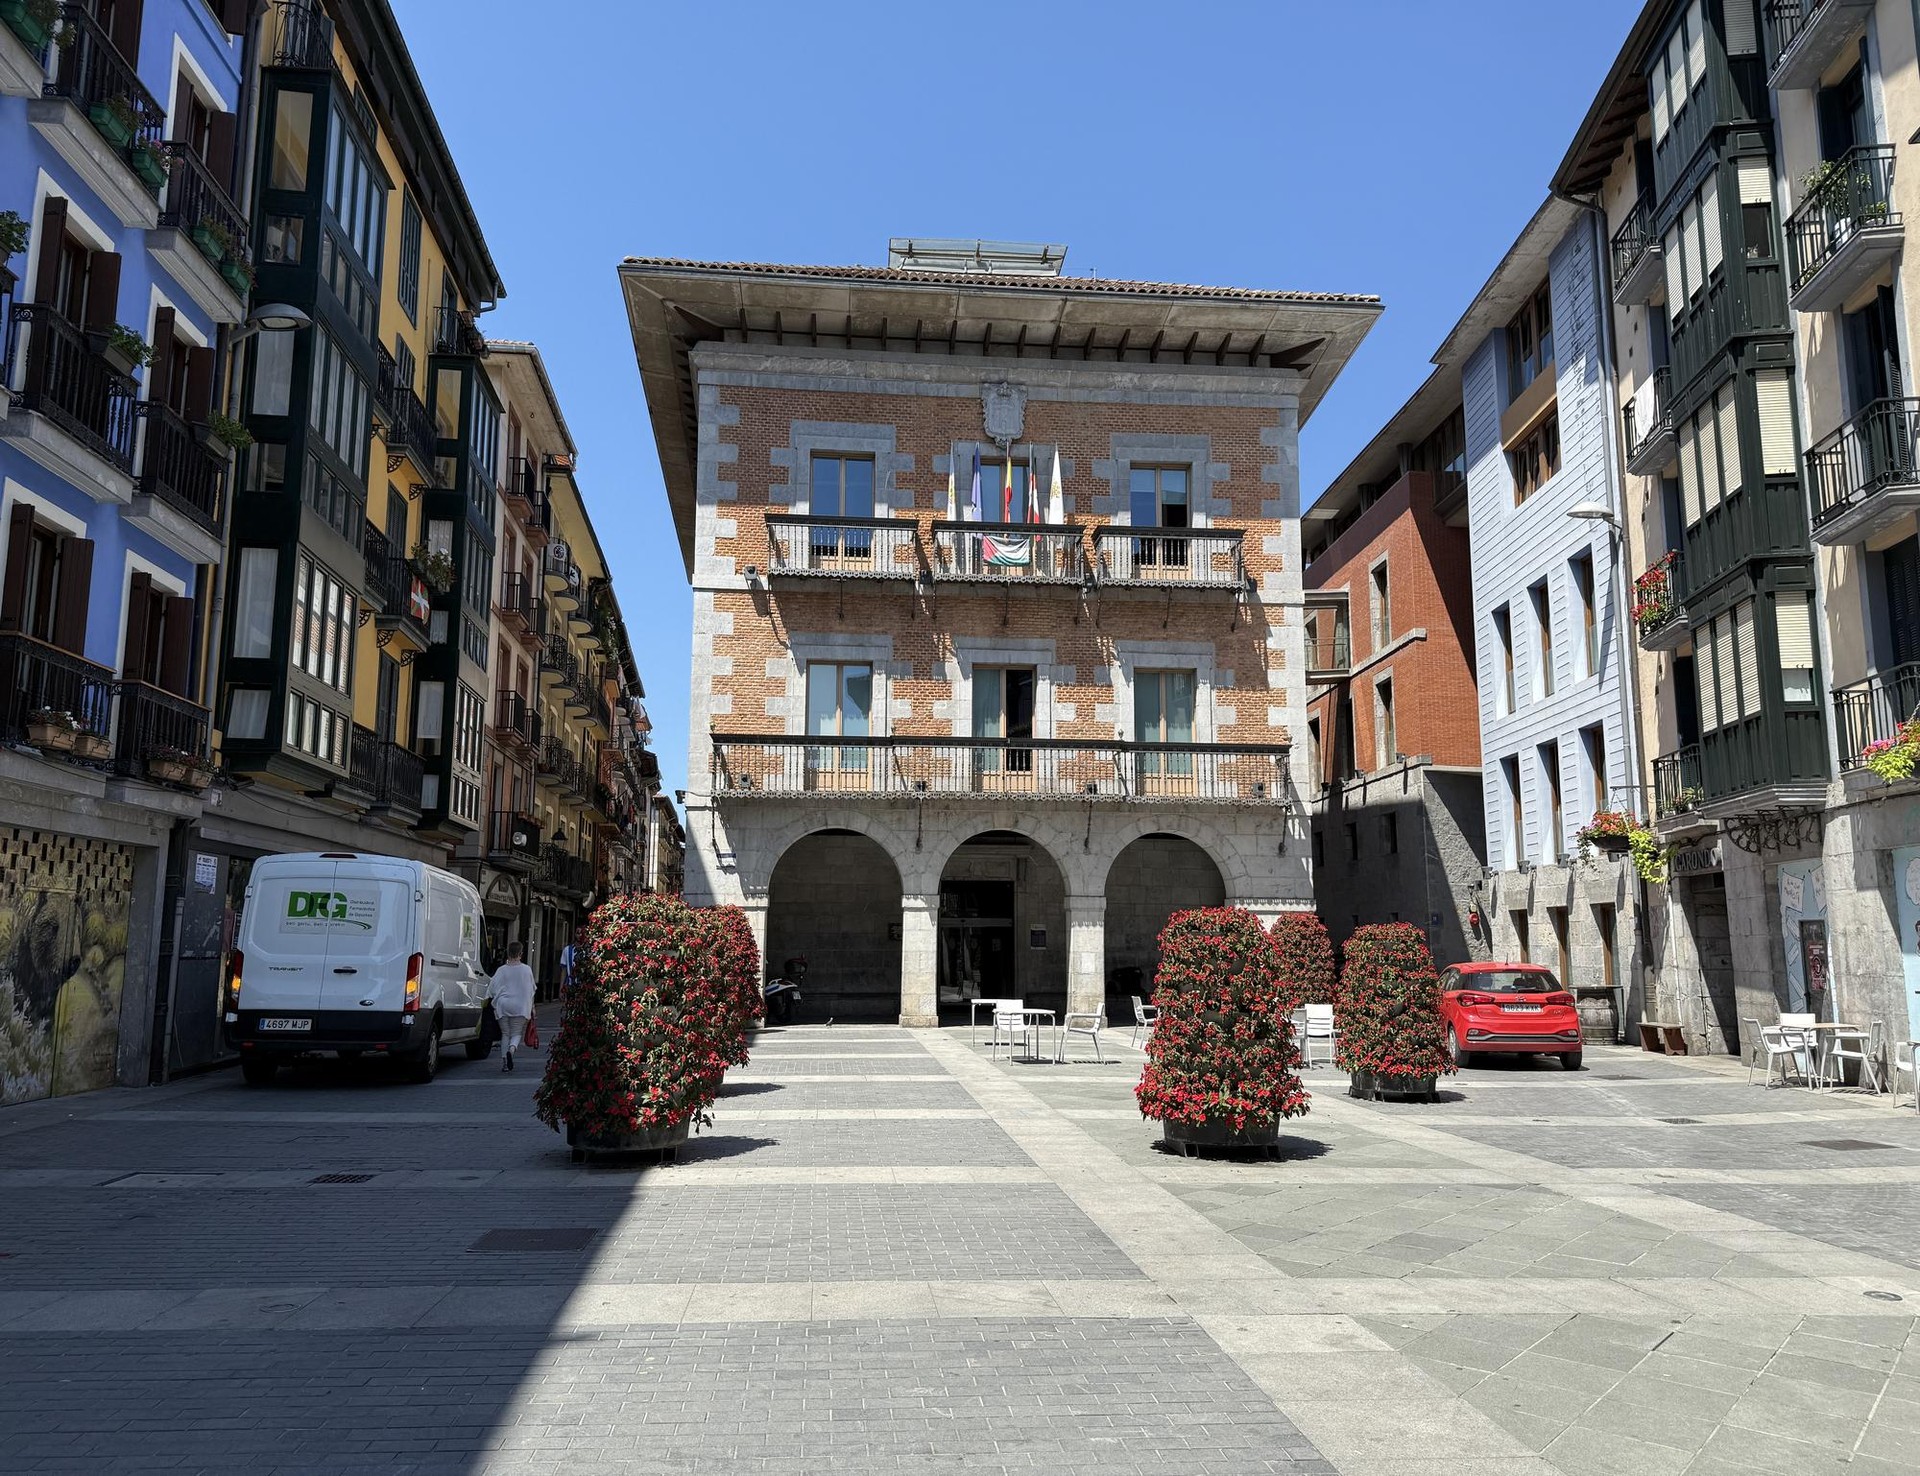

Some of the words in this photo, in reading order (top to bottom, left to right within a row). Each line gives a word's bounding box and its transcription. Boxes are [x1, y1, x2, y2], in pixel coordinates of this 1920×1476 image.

[287, 891, 347, 918] DFG
[266, 1019, 290, 1029] 4697
[292, 1020, 309, 1029] MJP
